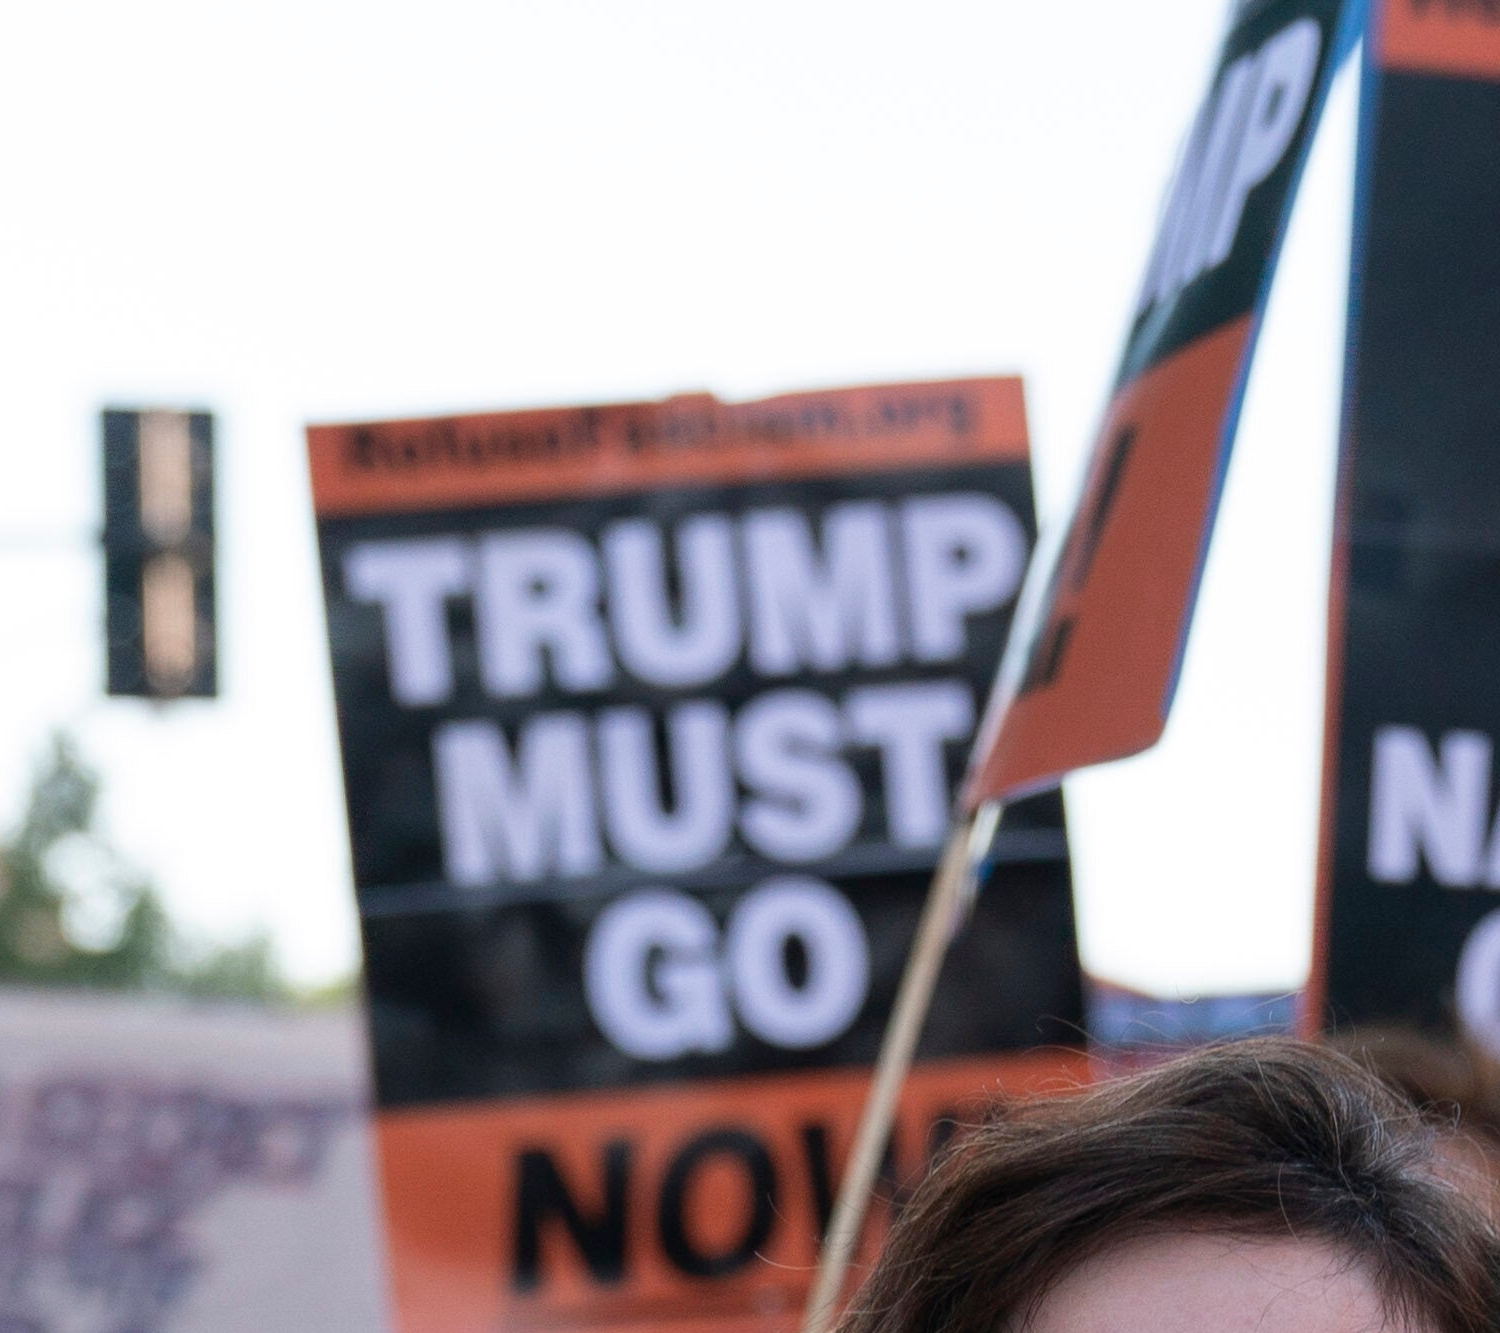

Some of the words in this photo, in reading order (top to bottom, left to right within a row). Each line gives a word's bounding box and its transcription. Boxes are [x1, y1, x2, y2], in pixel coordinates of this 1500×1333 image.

[342, 490, 1027, 710] TRUMP
[434, 681, 974, 889] MUST
[581, 874, 871, 1062] GO
